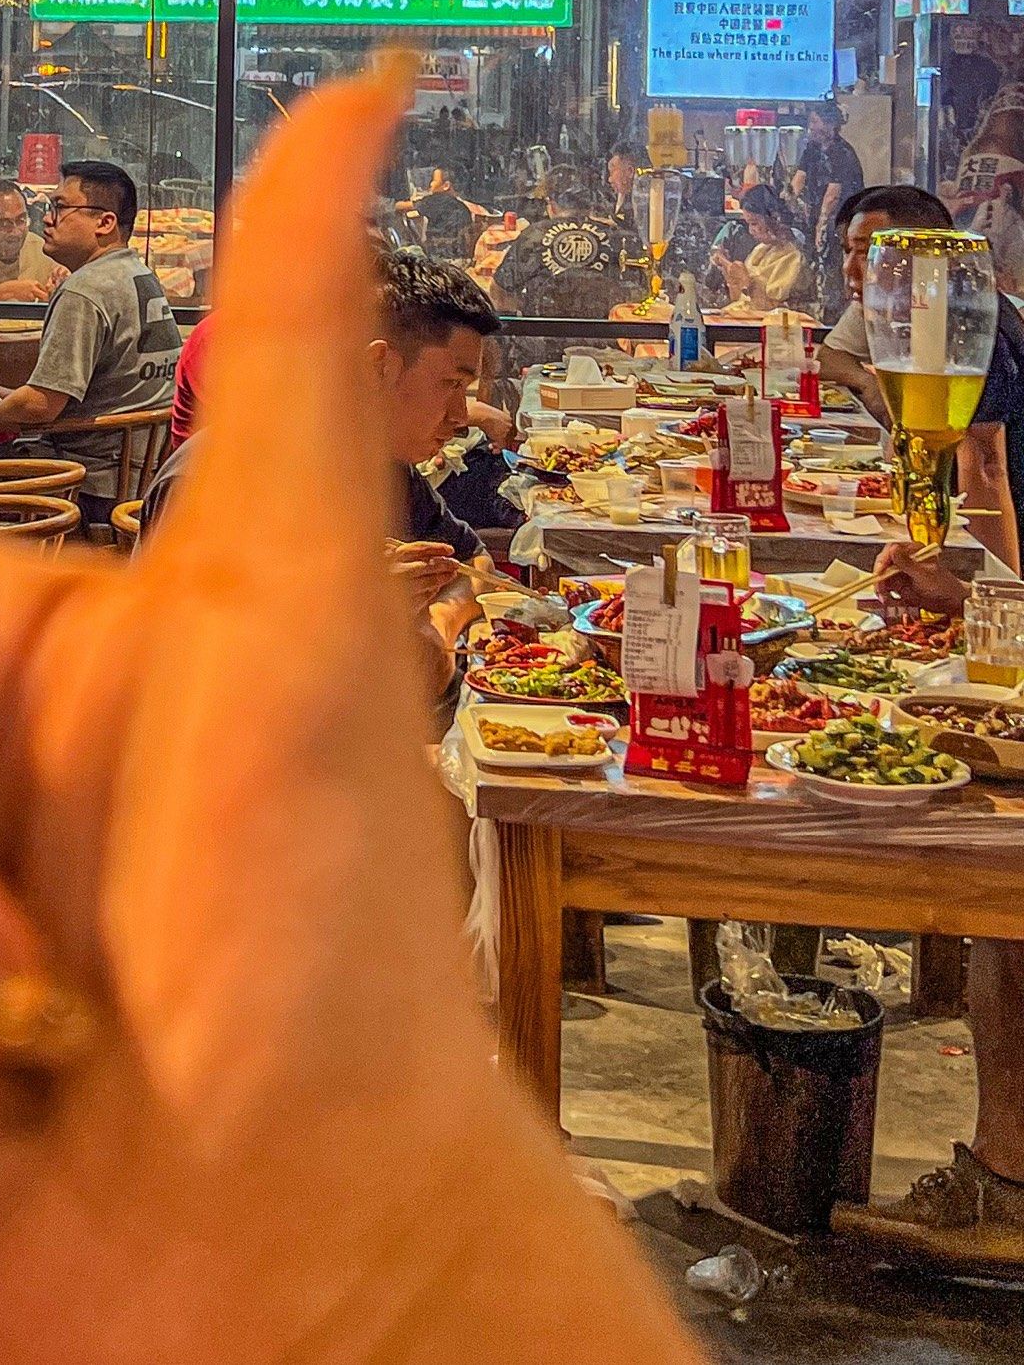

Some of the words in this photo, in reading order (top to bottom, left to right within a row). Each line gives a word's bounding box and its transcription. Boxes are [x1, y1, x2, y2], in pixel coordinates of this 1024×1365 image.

[652, 48, 672, 58] The
[675, 48, 704, 61] place
[707, 49, 741, 60] where
[751, 50, 781, 61] stand
[785, 50, 795, 61] is
[542, 222, 578, 246] CHINA
